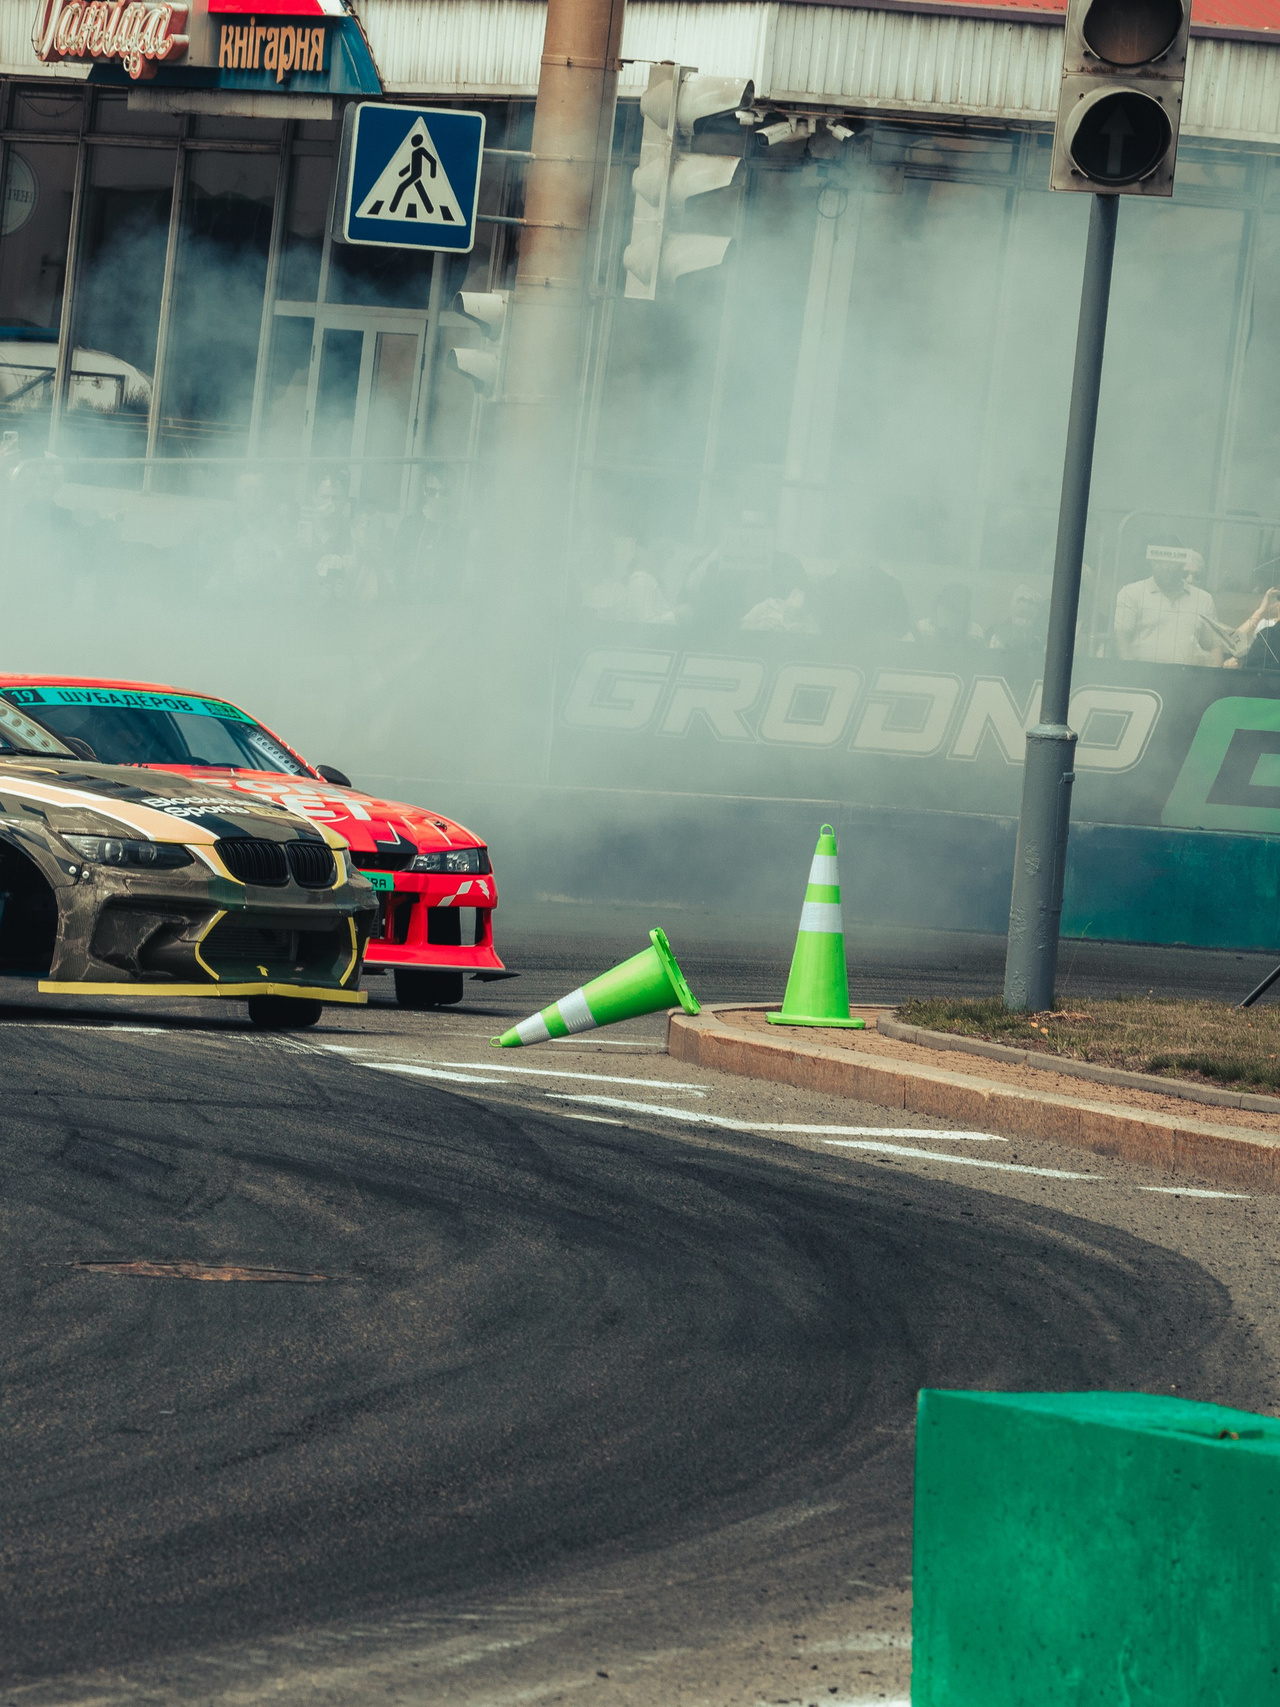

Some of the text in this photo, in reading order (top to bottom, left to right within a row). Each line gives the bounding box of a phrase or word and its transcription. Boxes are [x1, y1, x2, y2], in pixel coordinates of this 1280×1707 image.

[218, 16, 325, 84] кнігарня
[10, 690, 194, 712] 19 ШУБАДЁРОВ
[563, 646, 1163, 774] GRODNO
[164, 804, 251, 818] Sports
[250, 792, 374, 821] ET
[367, 876, 387, 889] RA
